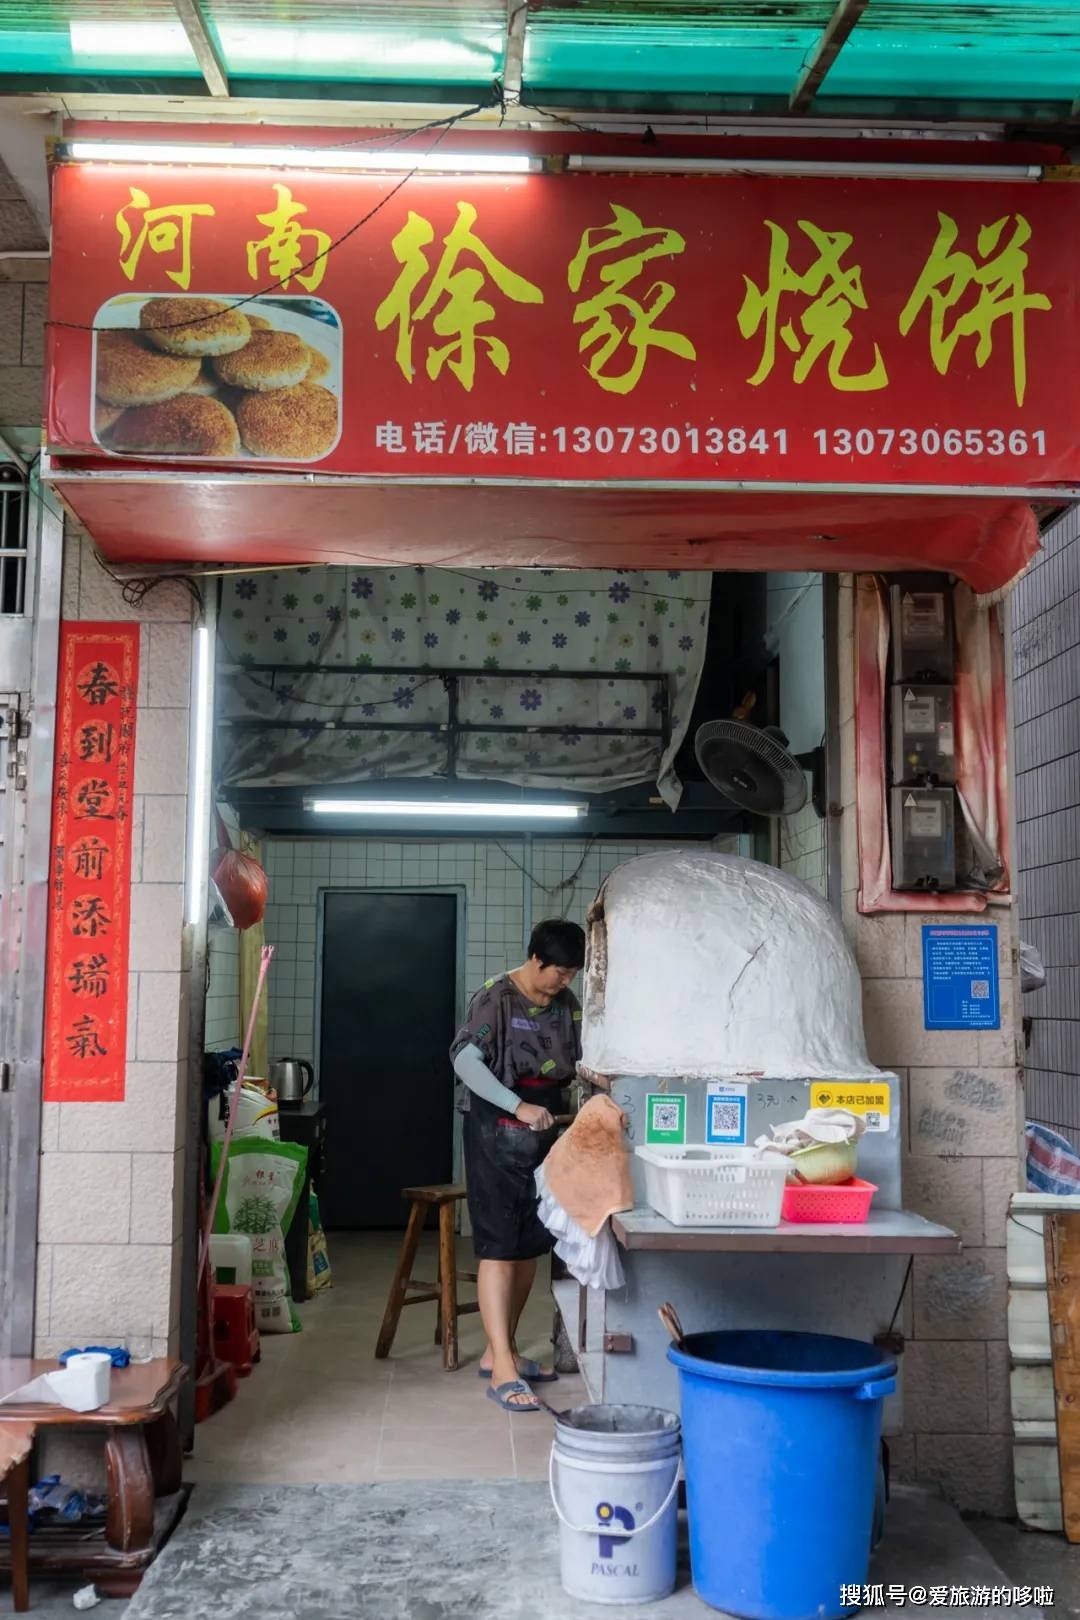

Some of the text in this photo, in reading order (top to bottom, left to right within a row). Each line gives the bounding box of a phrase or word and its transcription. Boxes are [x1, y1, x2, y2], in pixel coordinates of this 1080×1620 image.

[115, 184, 1052, 407] 河南 徐家烧饼
[813, 428, 1046, 456] 13073065361
[836, 1094, 885, 1105] 本店已加盟
[591, 1562, 640, 1577] PASCAL
